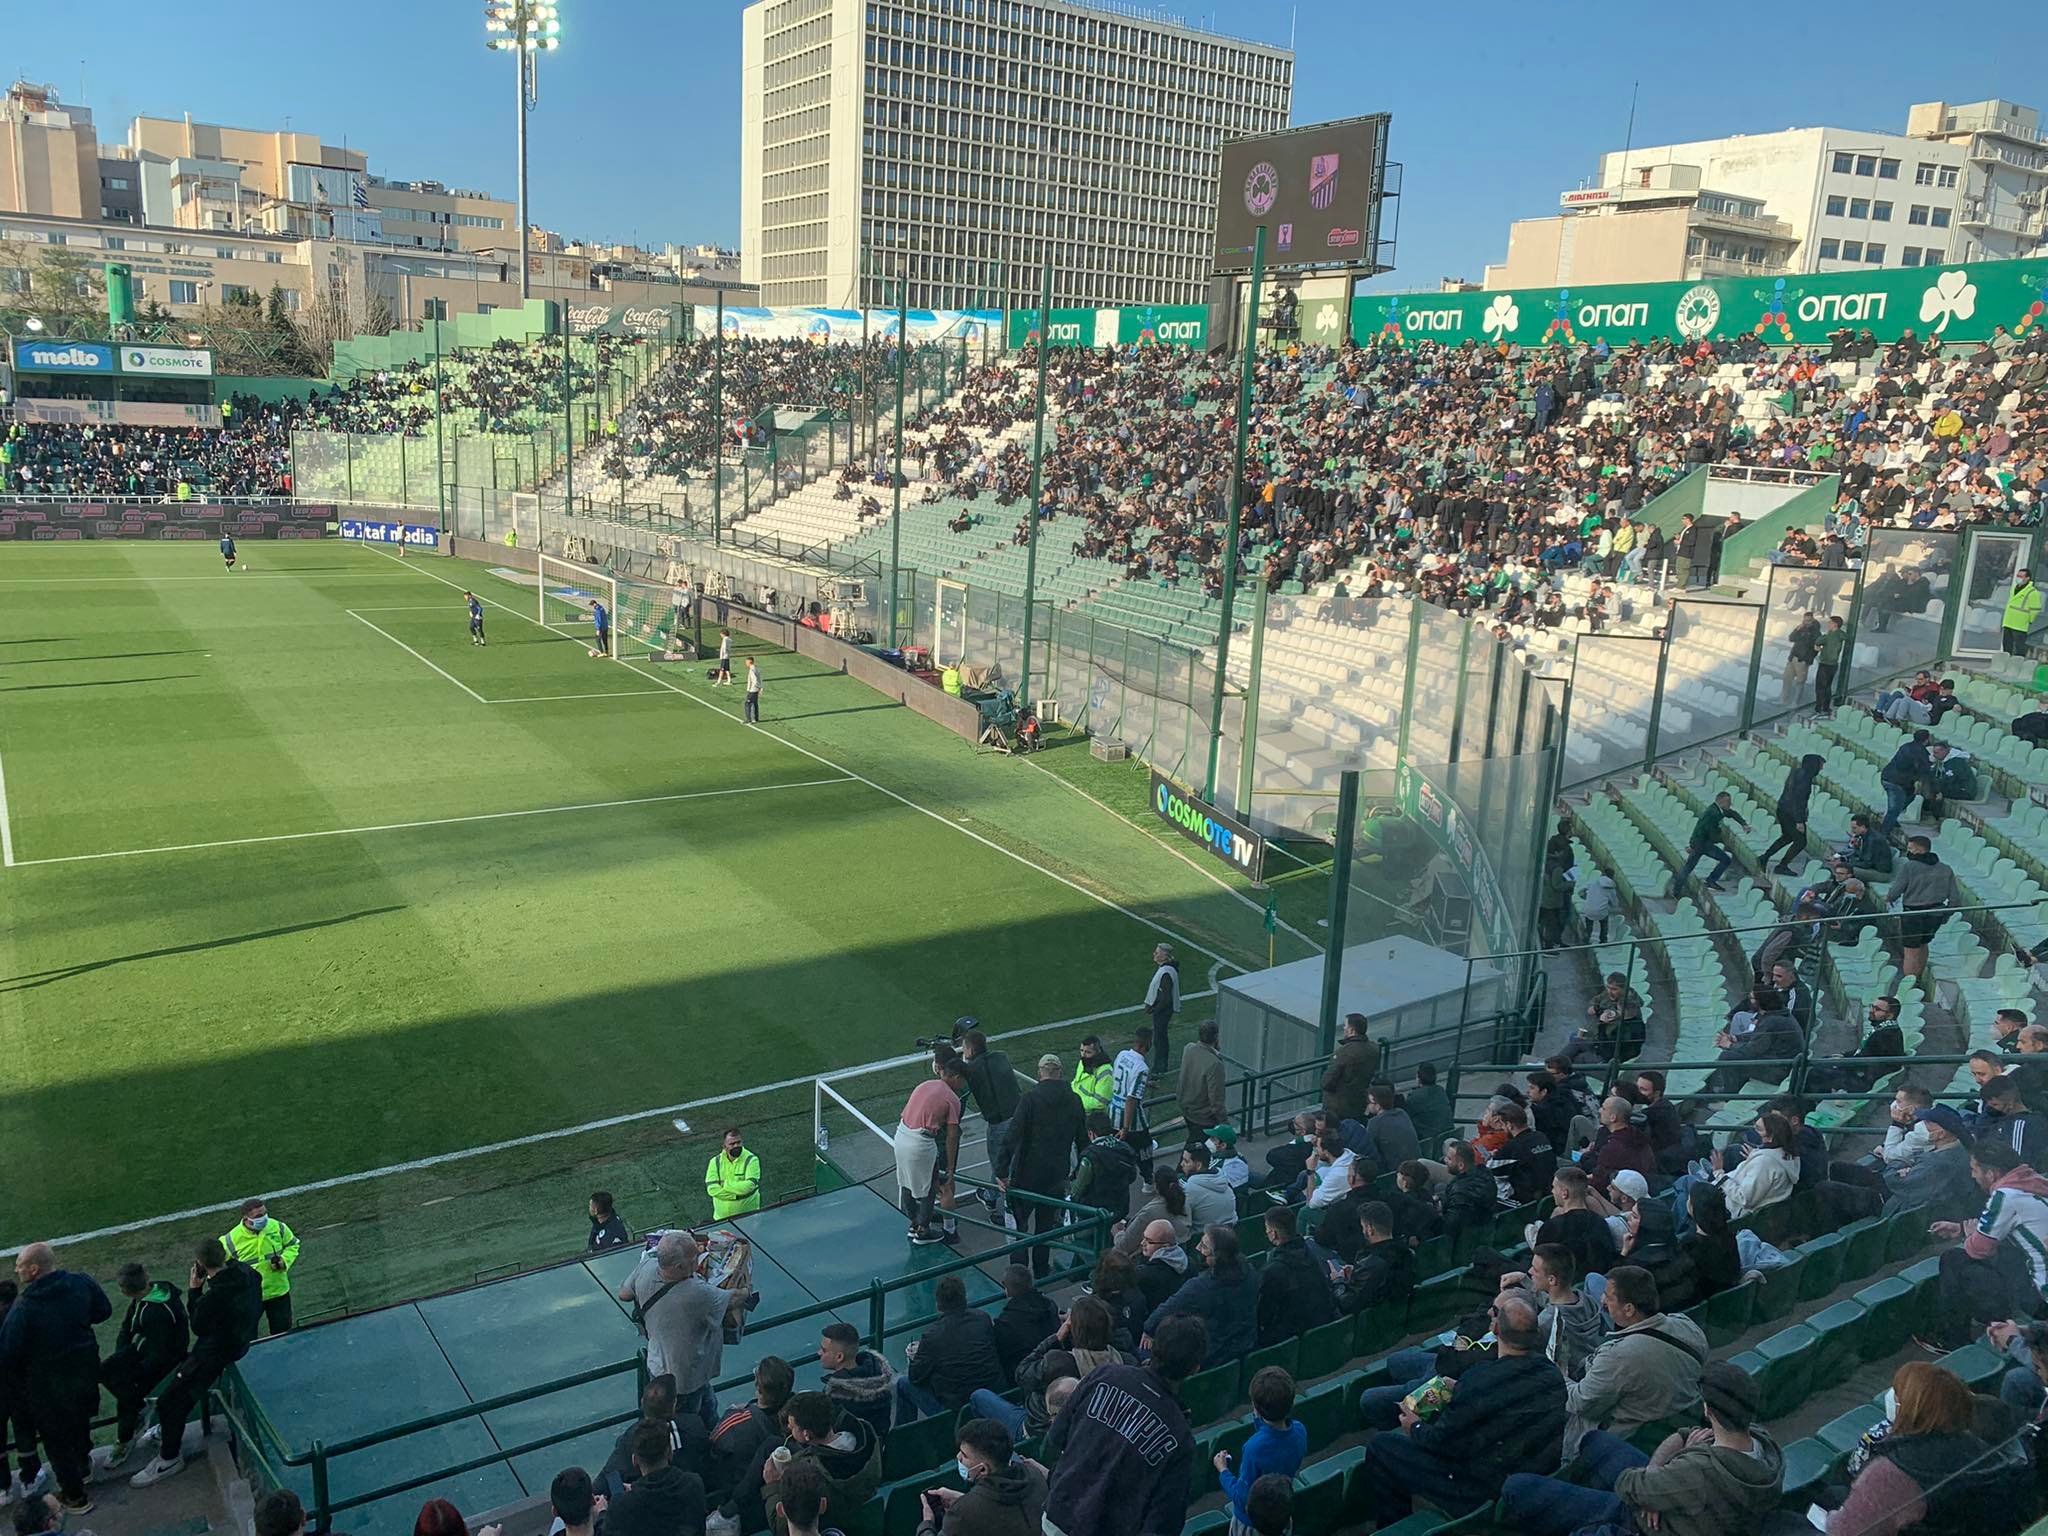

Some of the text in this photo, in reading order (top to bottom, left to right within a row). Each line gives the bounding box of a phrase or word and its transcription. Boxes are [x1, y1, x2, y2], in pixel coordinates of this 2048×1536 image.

[32, 349, 99, 366] molto
[150, 358, 203, 368] COSMOTE
[365, 525, 385, 540] taf
[1232, 834, 1254, 867] TV
[1087, 1382, 1179, 1467] OLYMPIC
